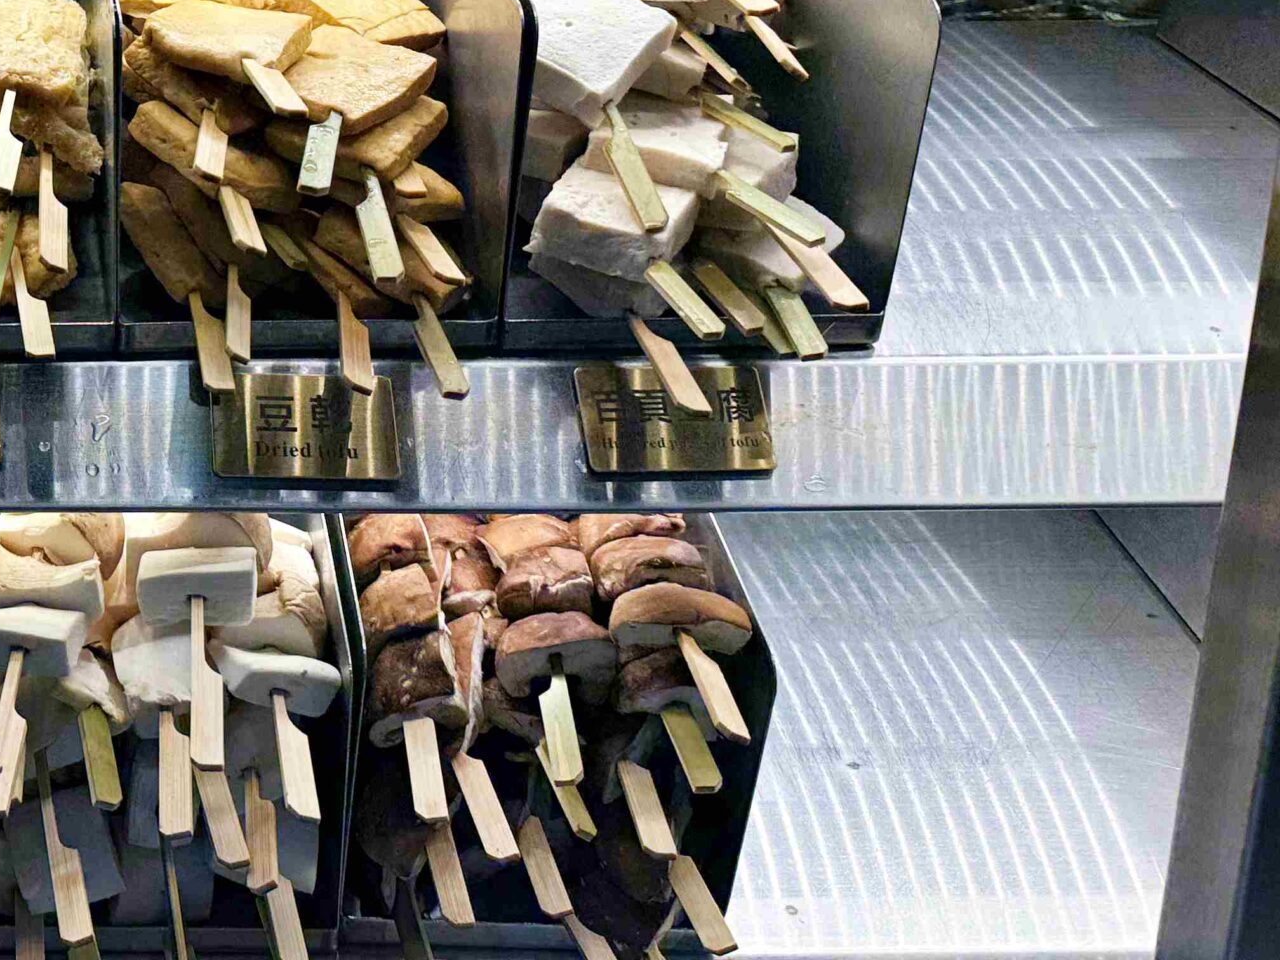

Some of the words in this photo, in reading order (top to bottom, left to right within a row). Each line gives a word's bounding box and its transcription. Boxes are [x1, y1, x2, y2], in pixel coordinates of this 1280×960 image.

[591, 387, 755, 423] 百頁腐
[256, 441, 311, 459] Dried
